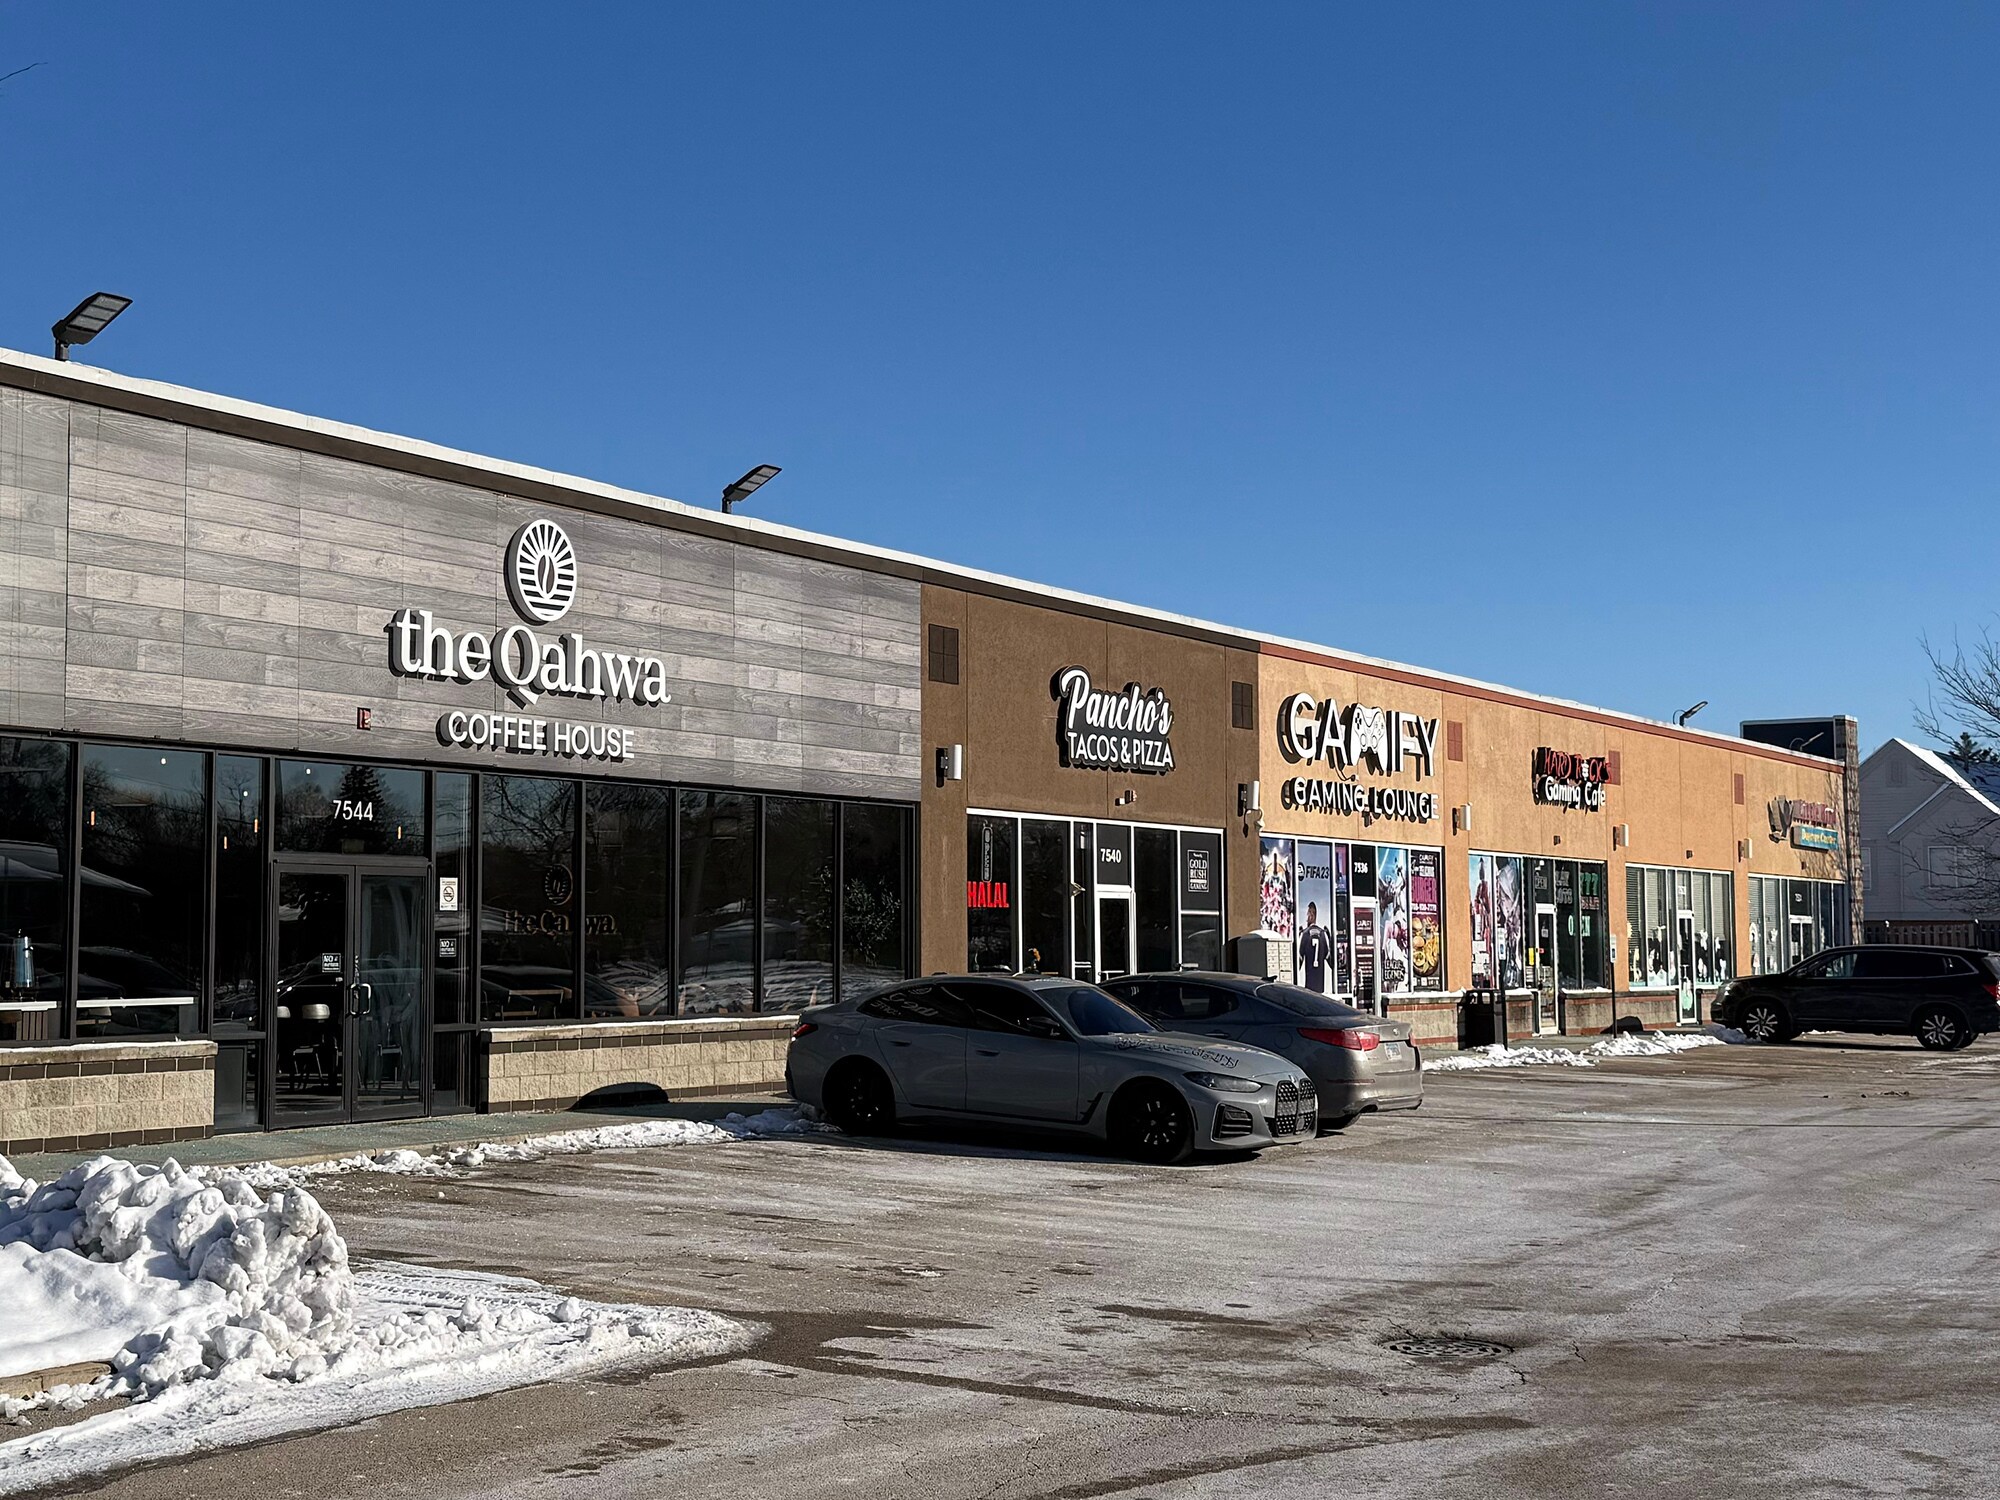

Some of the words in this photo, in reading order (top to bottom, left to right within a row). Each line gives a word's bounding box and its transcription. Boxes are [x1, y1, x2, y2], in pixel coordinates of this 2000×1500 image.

[397, 608, 671, 704] theQahwa
[1061, 669, 1173, 735] Pancho's
[448, 711, 547, 750] COFFEE
[554, 722, 635, 759] HOUSE
[1067, 731, 1119, 762] TACOS
[1120, 737, 1131, 764] &
[1133, 738, 1174, 768] PIZZA
[1294, 776, 1366, 812] GAMING
[1373, 788, 1440, 820] LOUNGE
[1545, 775, 1581, 810] Gaming
[333, 799, 374, 821] 7544
[1100, 848, 1122, 863] 7540
[1189, 859, 1208, 869] GOLD
[1305, 865, 1320, 879] FIFA
[1321, 867, 1330, 880] 23
[966, 880, 1010, 908] HALAL
[1567, 914, 1591, 937] OEN
[1311, 938, 1320, 968] 7
